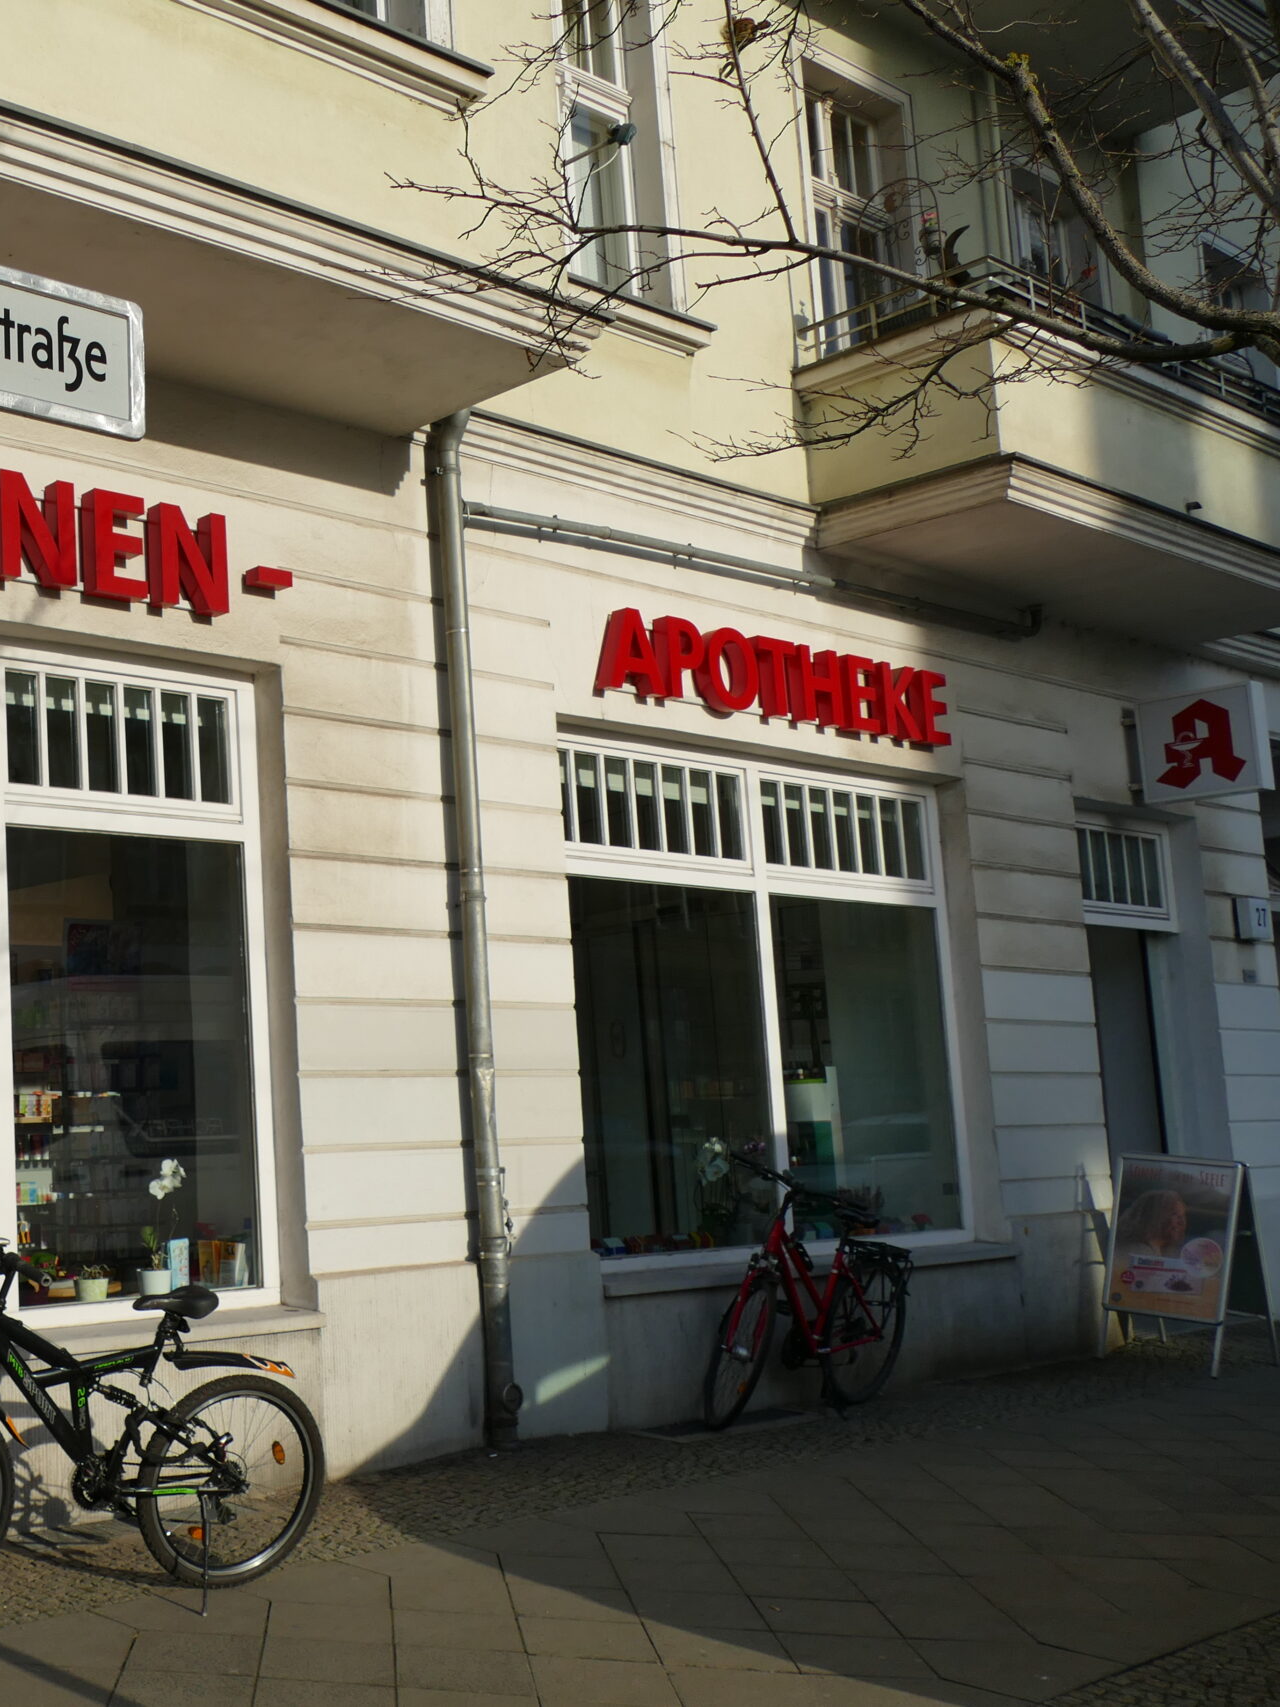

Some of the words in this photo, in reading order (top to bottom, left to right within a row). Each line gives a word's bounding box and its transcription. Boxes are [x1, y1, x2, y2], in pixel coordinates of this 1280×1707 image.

[596, 607, 952, 747] APOTHEKE
[1255, 907, 1267, 928] 27
[77, 1387, 86, 1408] 26
